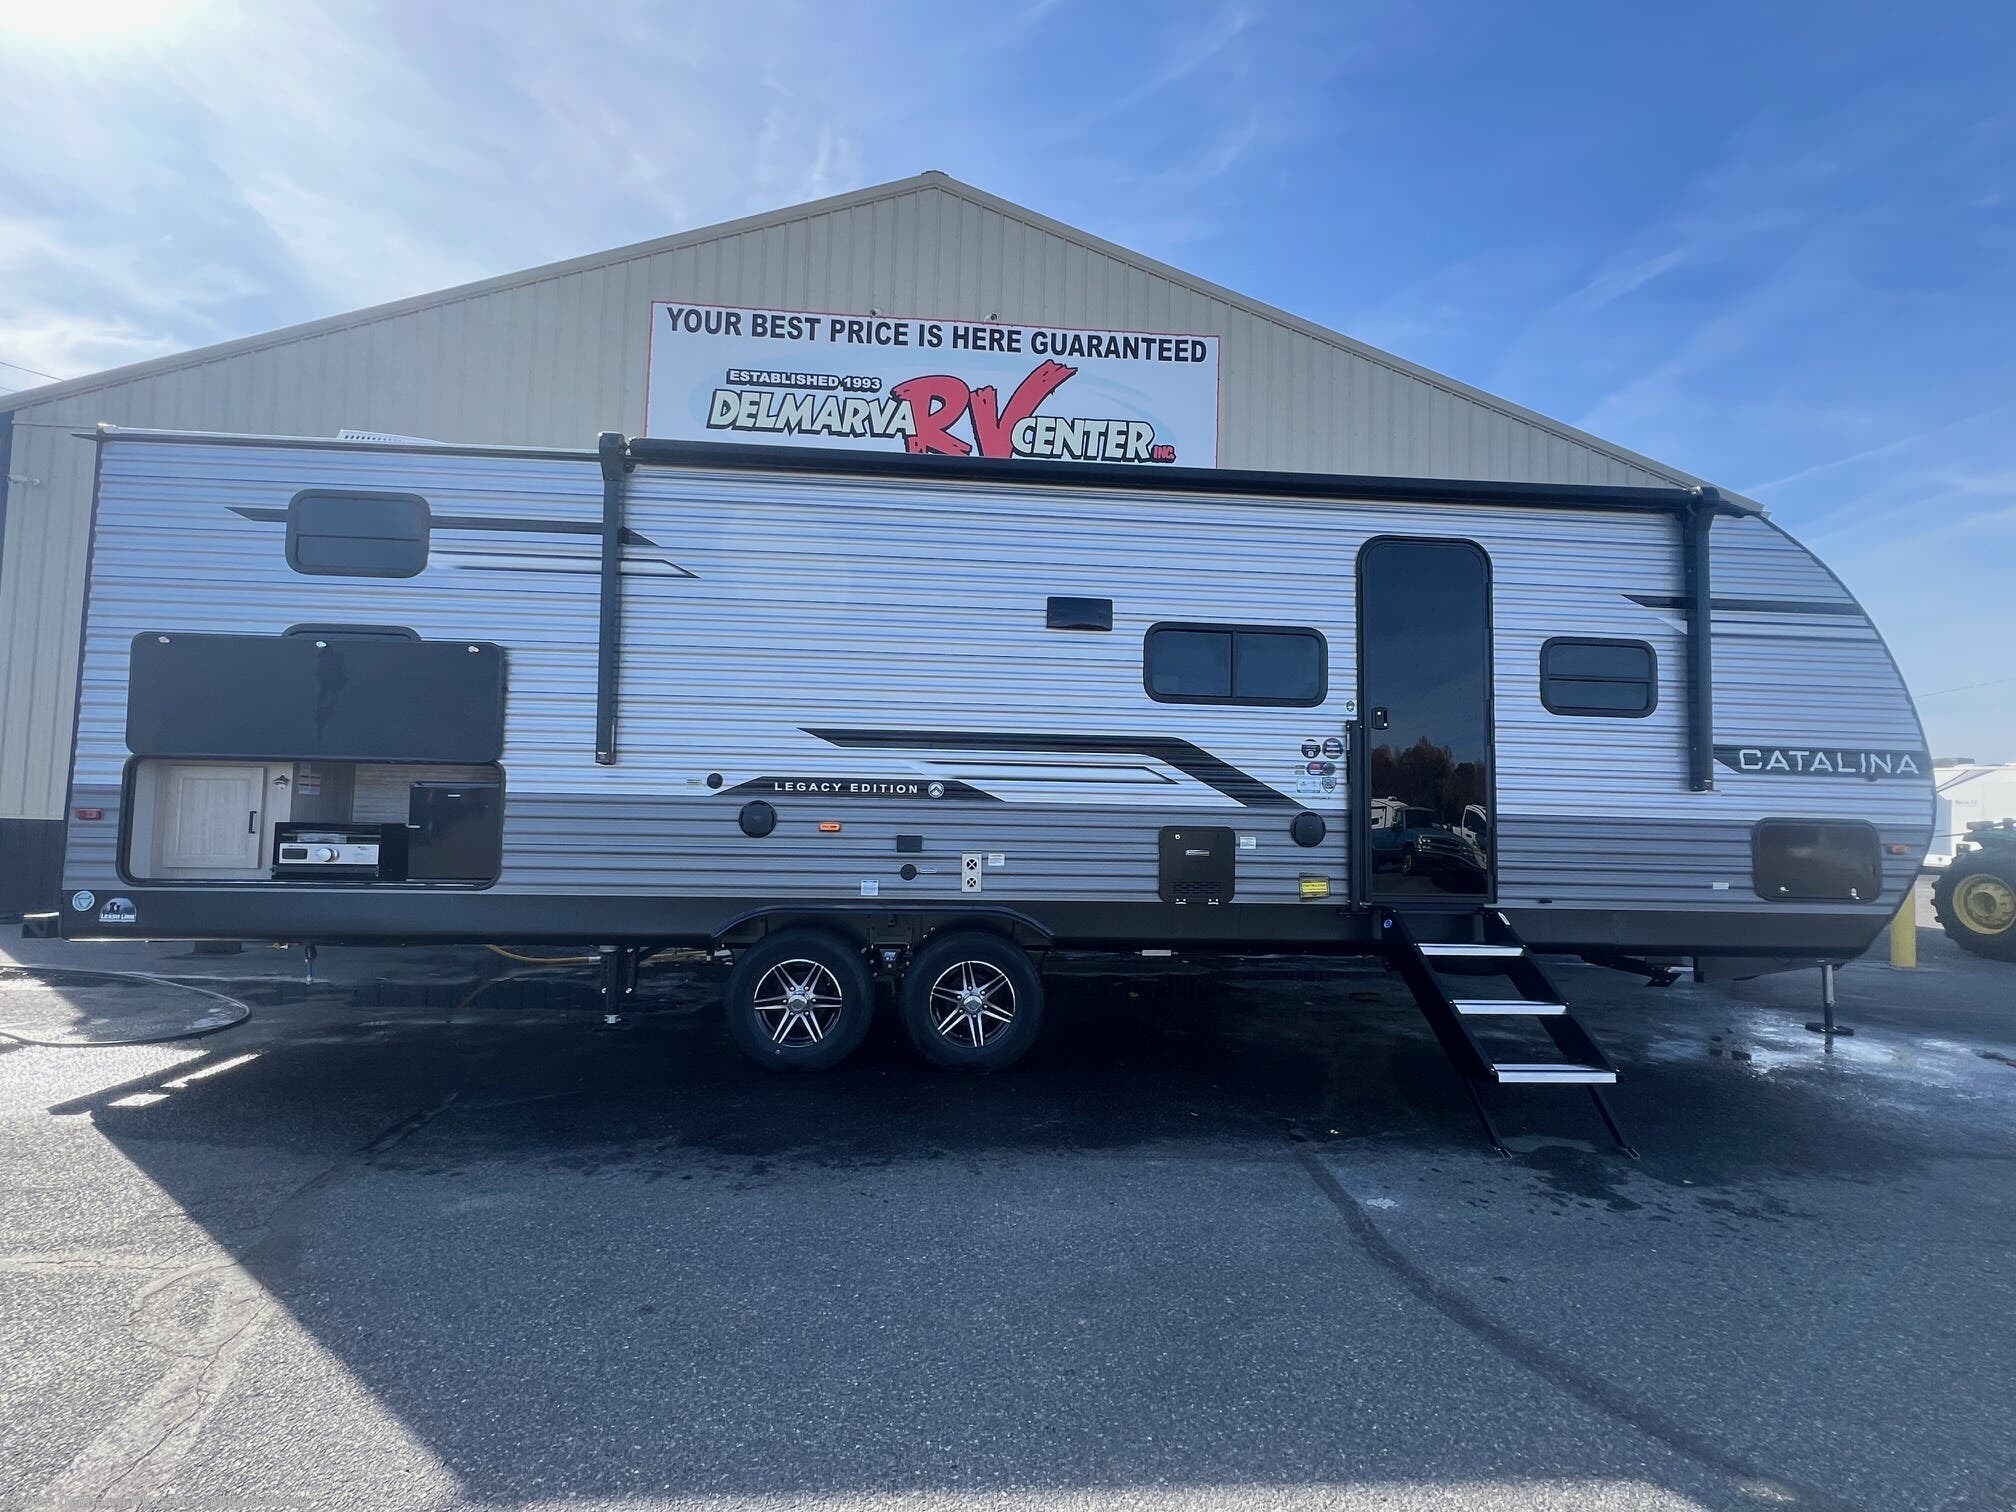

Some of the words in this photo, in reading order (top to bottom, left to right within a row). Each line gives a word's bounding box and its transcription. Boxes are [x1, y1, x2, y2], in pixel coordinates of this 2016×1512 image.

[666, 307, 743, 337] YOUR
[751, 313, 821, 341] BEST
[830, 319, 909, 347] PRICE
[919, 324, 943, 348] IS
[952, 326, 1022, 353] HERE
[1031, 331, 1207, 363] GUARANTEED
[728, 370, 840, 388] ESTABLISHED
[843, 375, 882, 392] 1993
[706, 389, 918, 438] DELMARVA
[890, 359, 1079, 459] RV
[1011, 416, 1155, 463] CENTER
[1739, 749, 1920, 775] CATALINA
[774, 782, 842, 792] LEGACY
[850, 783, 918, 794] EDITION
